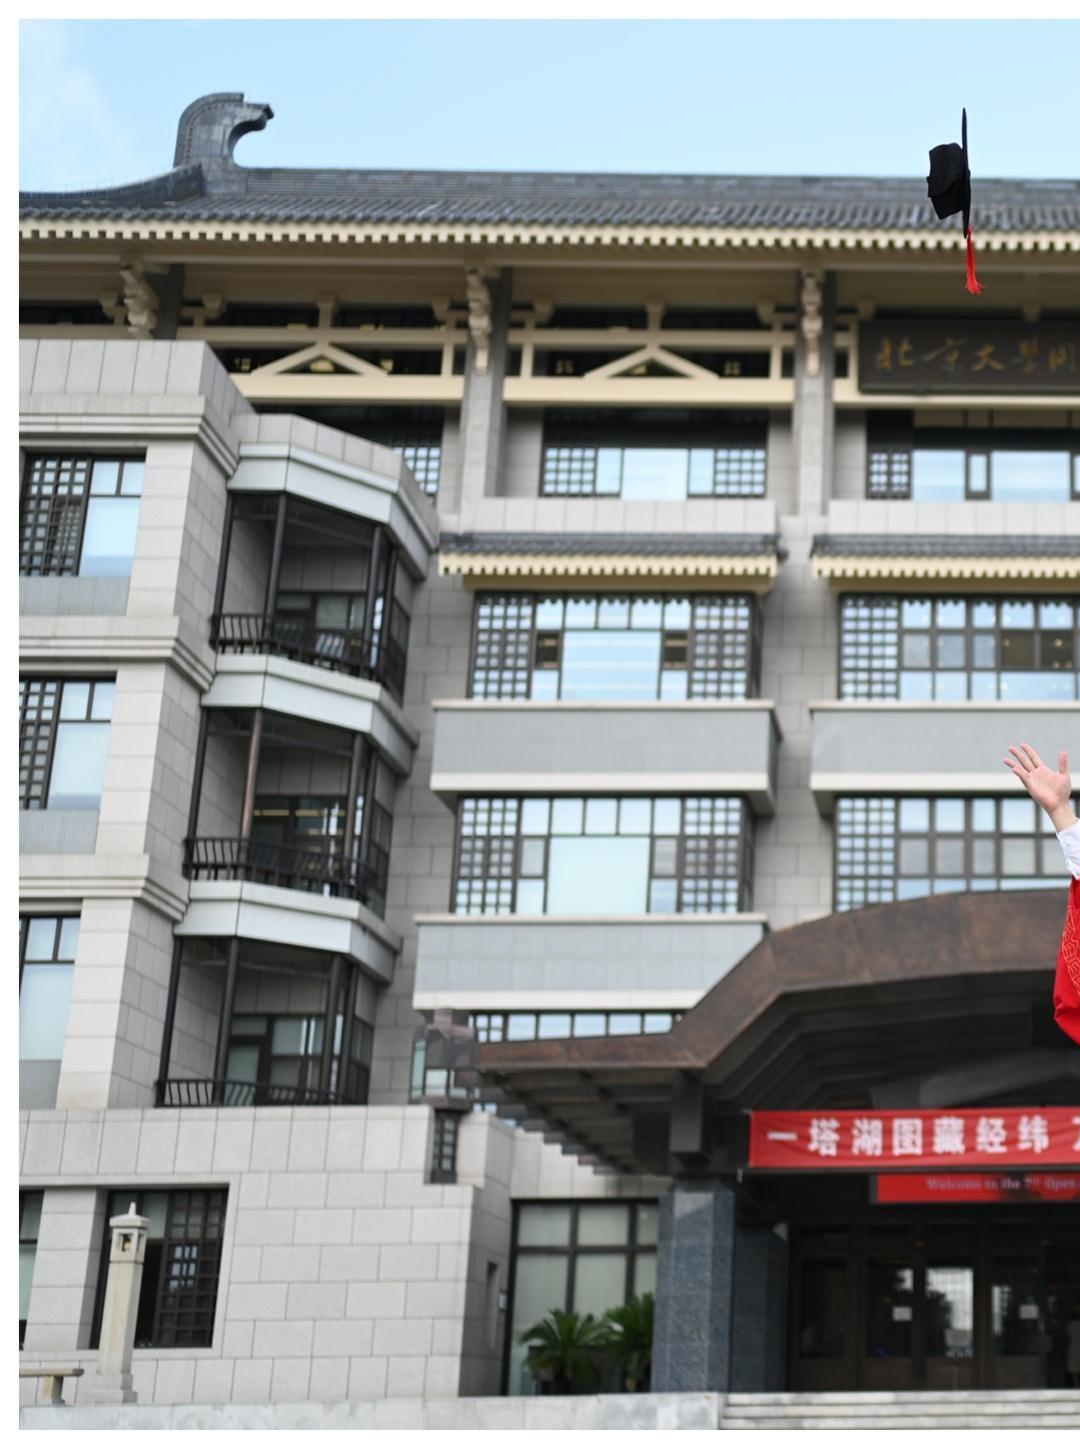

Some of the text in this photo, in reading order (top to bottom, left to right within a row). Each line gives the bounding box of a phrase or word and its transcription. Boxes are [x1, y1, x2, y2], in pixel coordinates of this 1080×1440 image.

[767, 1116, 1050, 1156] 一塔湖图藏经纬
